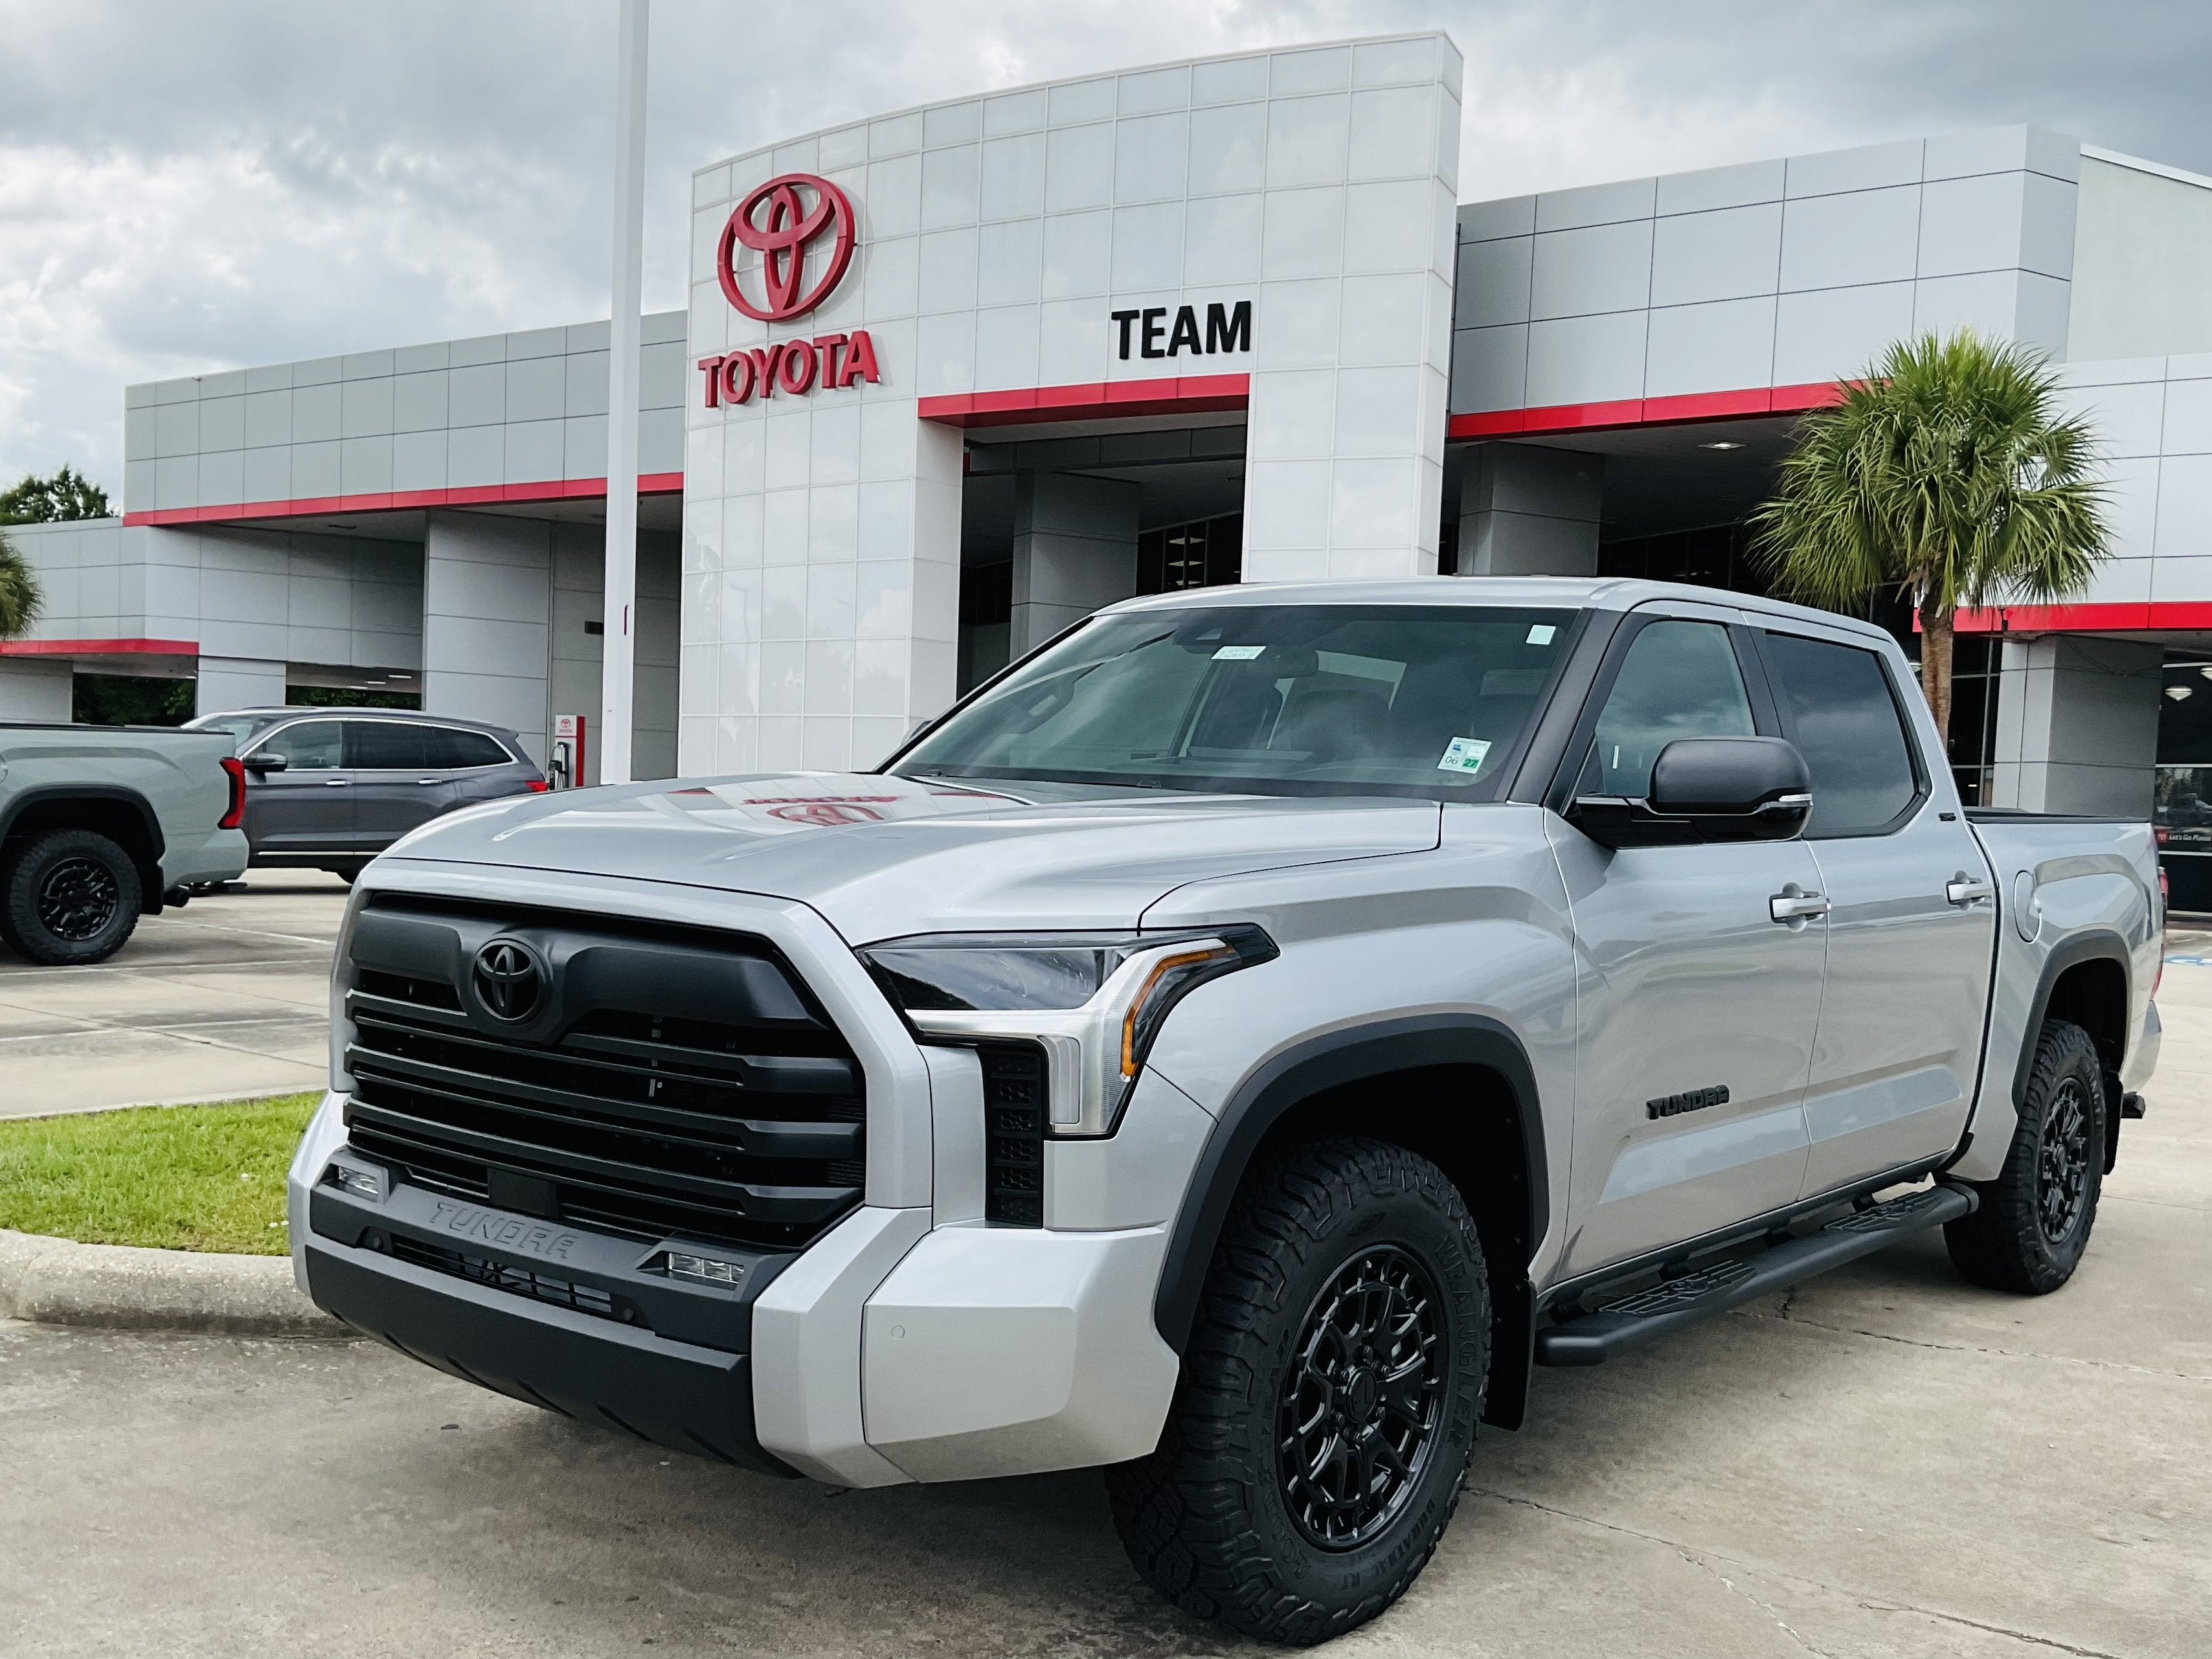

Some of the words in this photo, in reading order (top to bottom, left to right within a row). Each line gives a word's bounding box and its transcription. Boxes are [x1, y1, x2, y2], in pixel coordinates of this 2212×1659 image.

[1111, 300, 1252, 360] TEAM
[697, 330, 881, 409] TOYOTA
[1445, 756, 1459, 765] 06
[1463, 759, 1478, 768] 27
[1645, 1084, 1730, 1120] TUNDRA
[430, 1201, 579, 1259] TUNDRA
